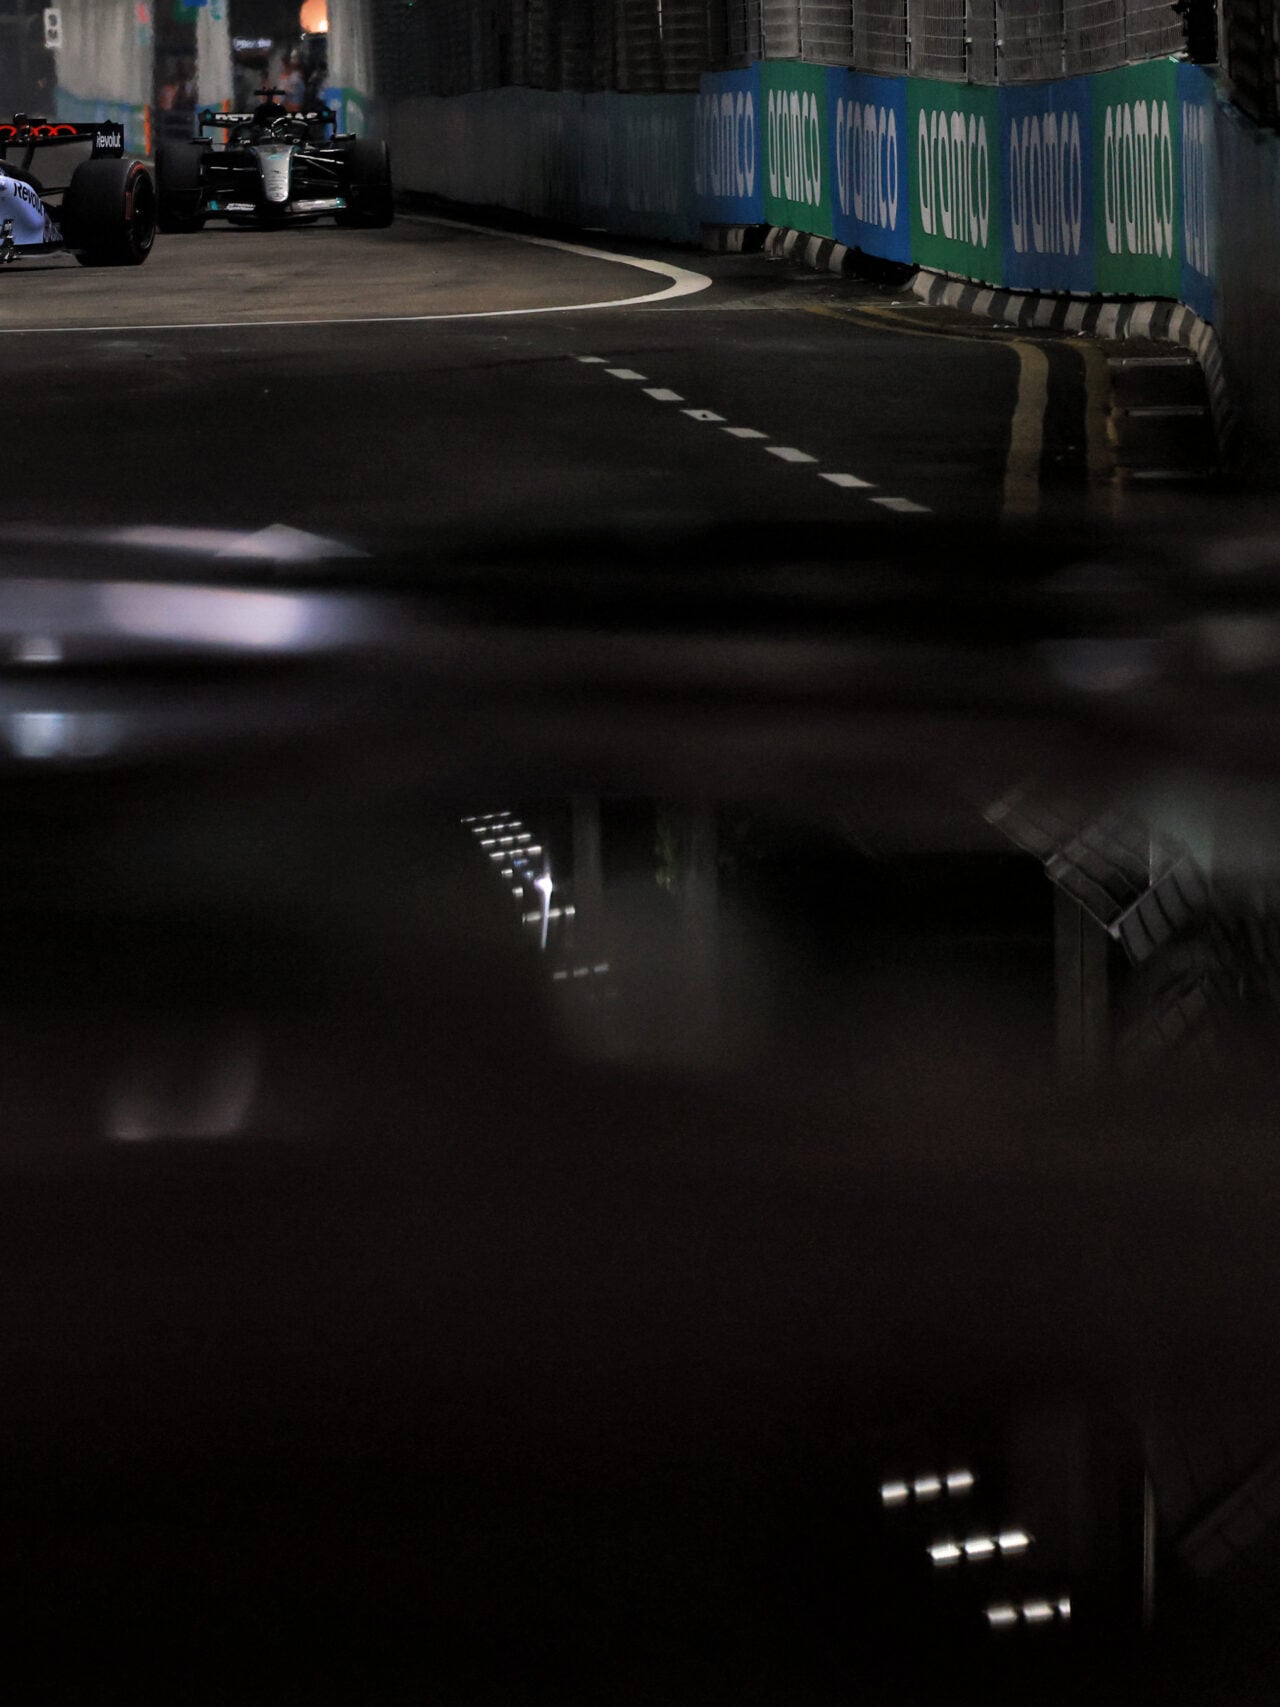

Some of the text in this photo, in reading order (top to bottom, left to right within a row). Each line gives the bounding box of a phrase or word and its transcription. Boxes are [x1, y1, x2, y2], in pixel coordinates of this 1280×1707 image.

[96, 131, 121, 148] Revolut
[767, 88, 821, 208] aramco
[835, 96, 898, 232] aramco
[917, 107, 990, 249] aramco
[1010, 111, 1081, 256] aramco
[1104, 99, 1173, 259] aramco
